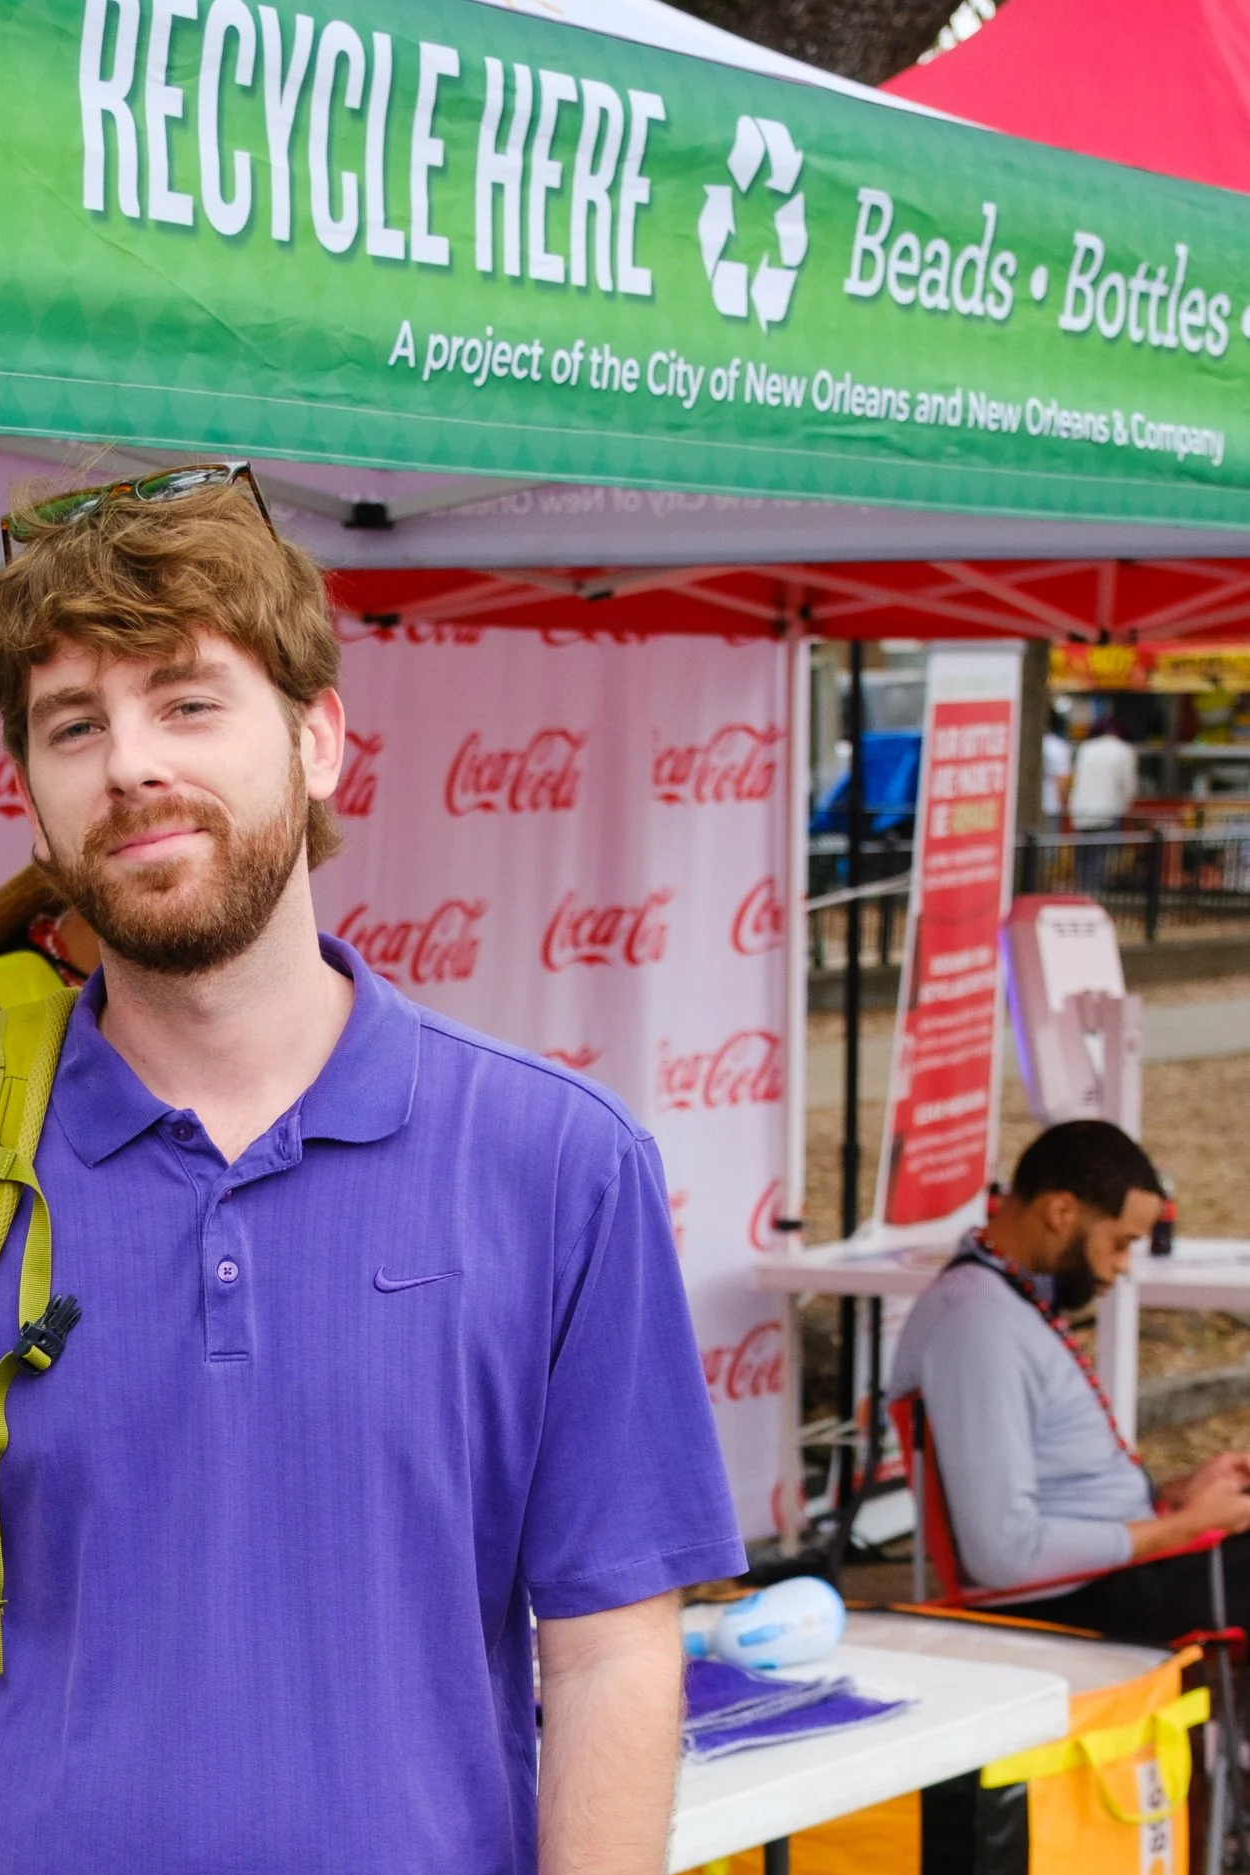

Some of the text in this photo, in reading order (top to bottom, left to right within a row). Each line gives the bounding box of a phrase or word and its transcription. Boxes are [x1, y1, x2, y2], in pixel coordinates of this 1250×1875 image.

[79, 0, 667, 296] RECYCLE HERE
[844, 187, 1231, 358] Beads Bottles
[387, 319, 1226, 467] A project of the City of New Orleans and New Orleans & Company
